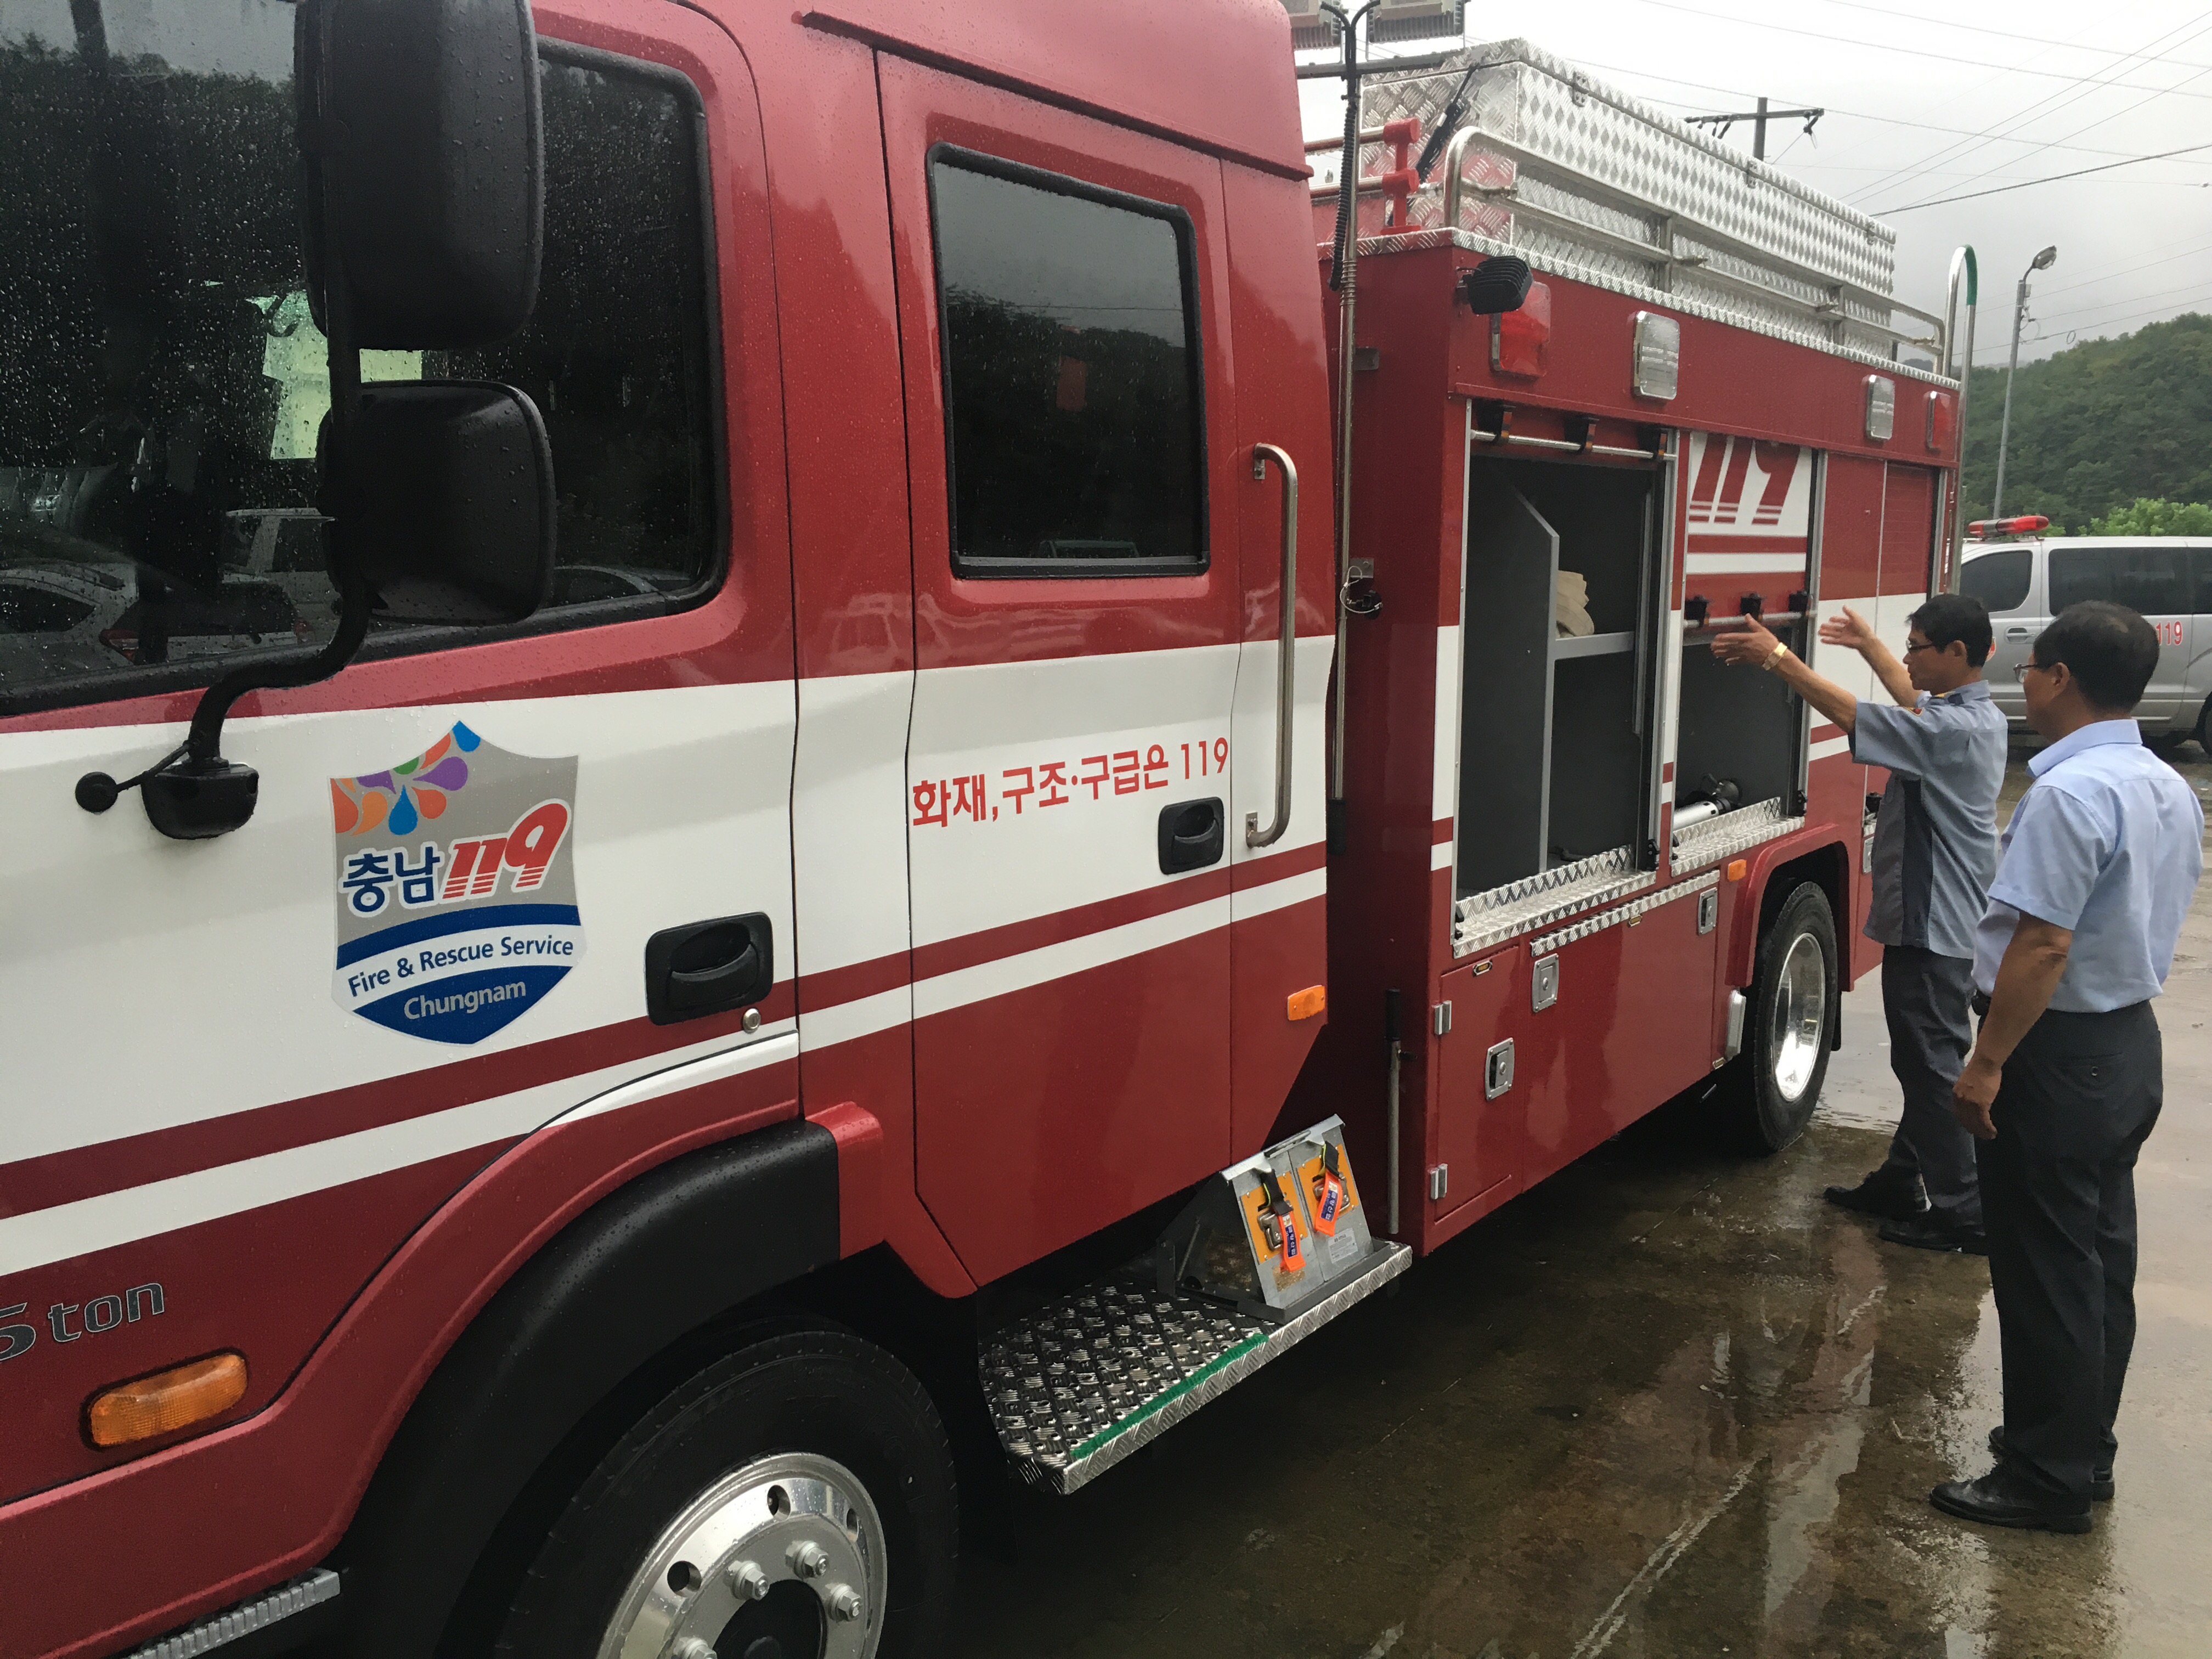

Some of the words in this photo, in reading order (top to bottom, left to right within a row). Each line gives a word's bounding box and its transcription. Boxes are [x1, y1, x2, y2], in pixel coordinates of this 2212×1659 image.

[2155, 620, 2182, 645] 119
[1181, 737, 1229, 780] 119
[347, 967, 391, 997] Fire
[396, 958, 414, 979] &
[419, 940, 494, 972] Rescue
[500, 935, 574, 957] Service
[403, 981, 527, 1020] Chungnam
[47, 1282, 165, 1342] ton
